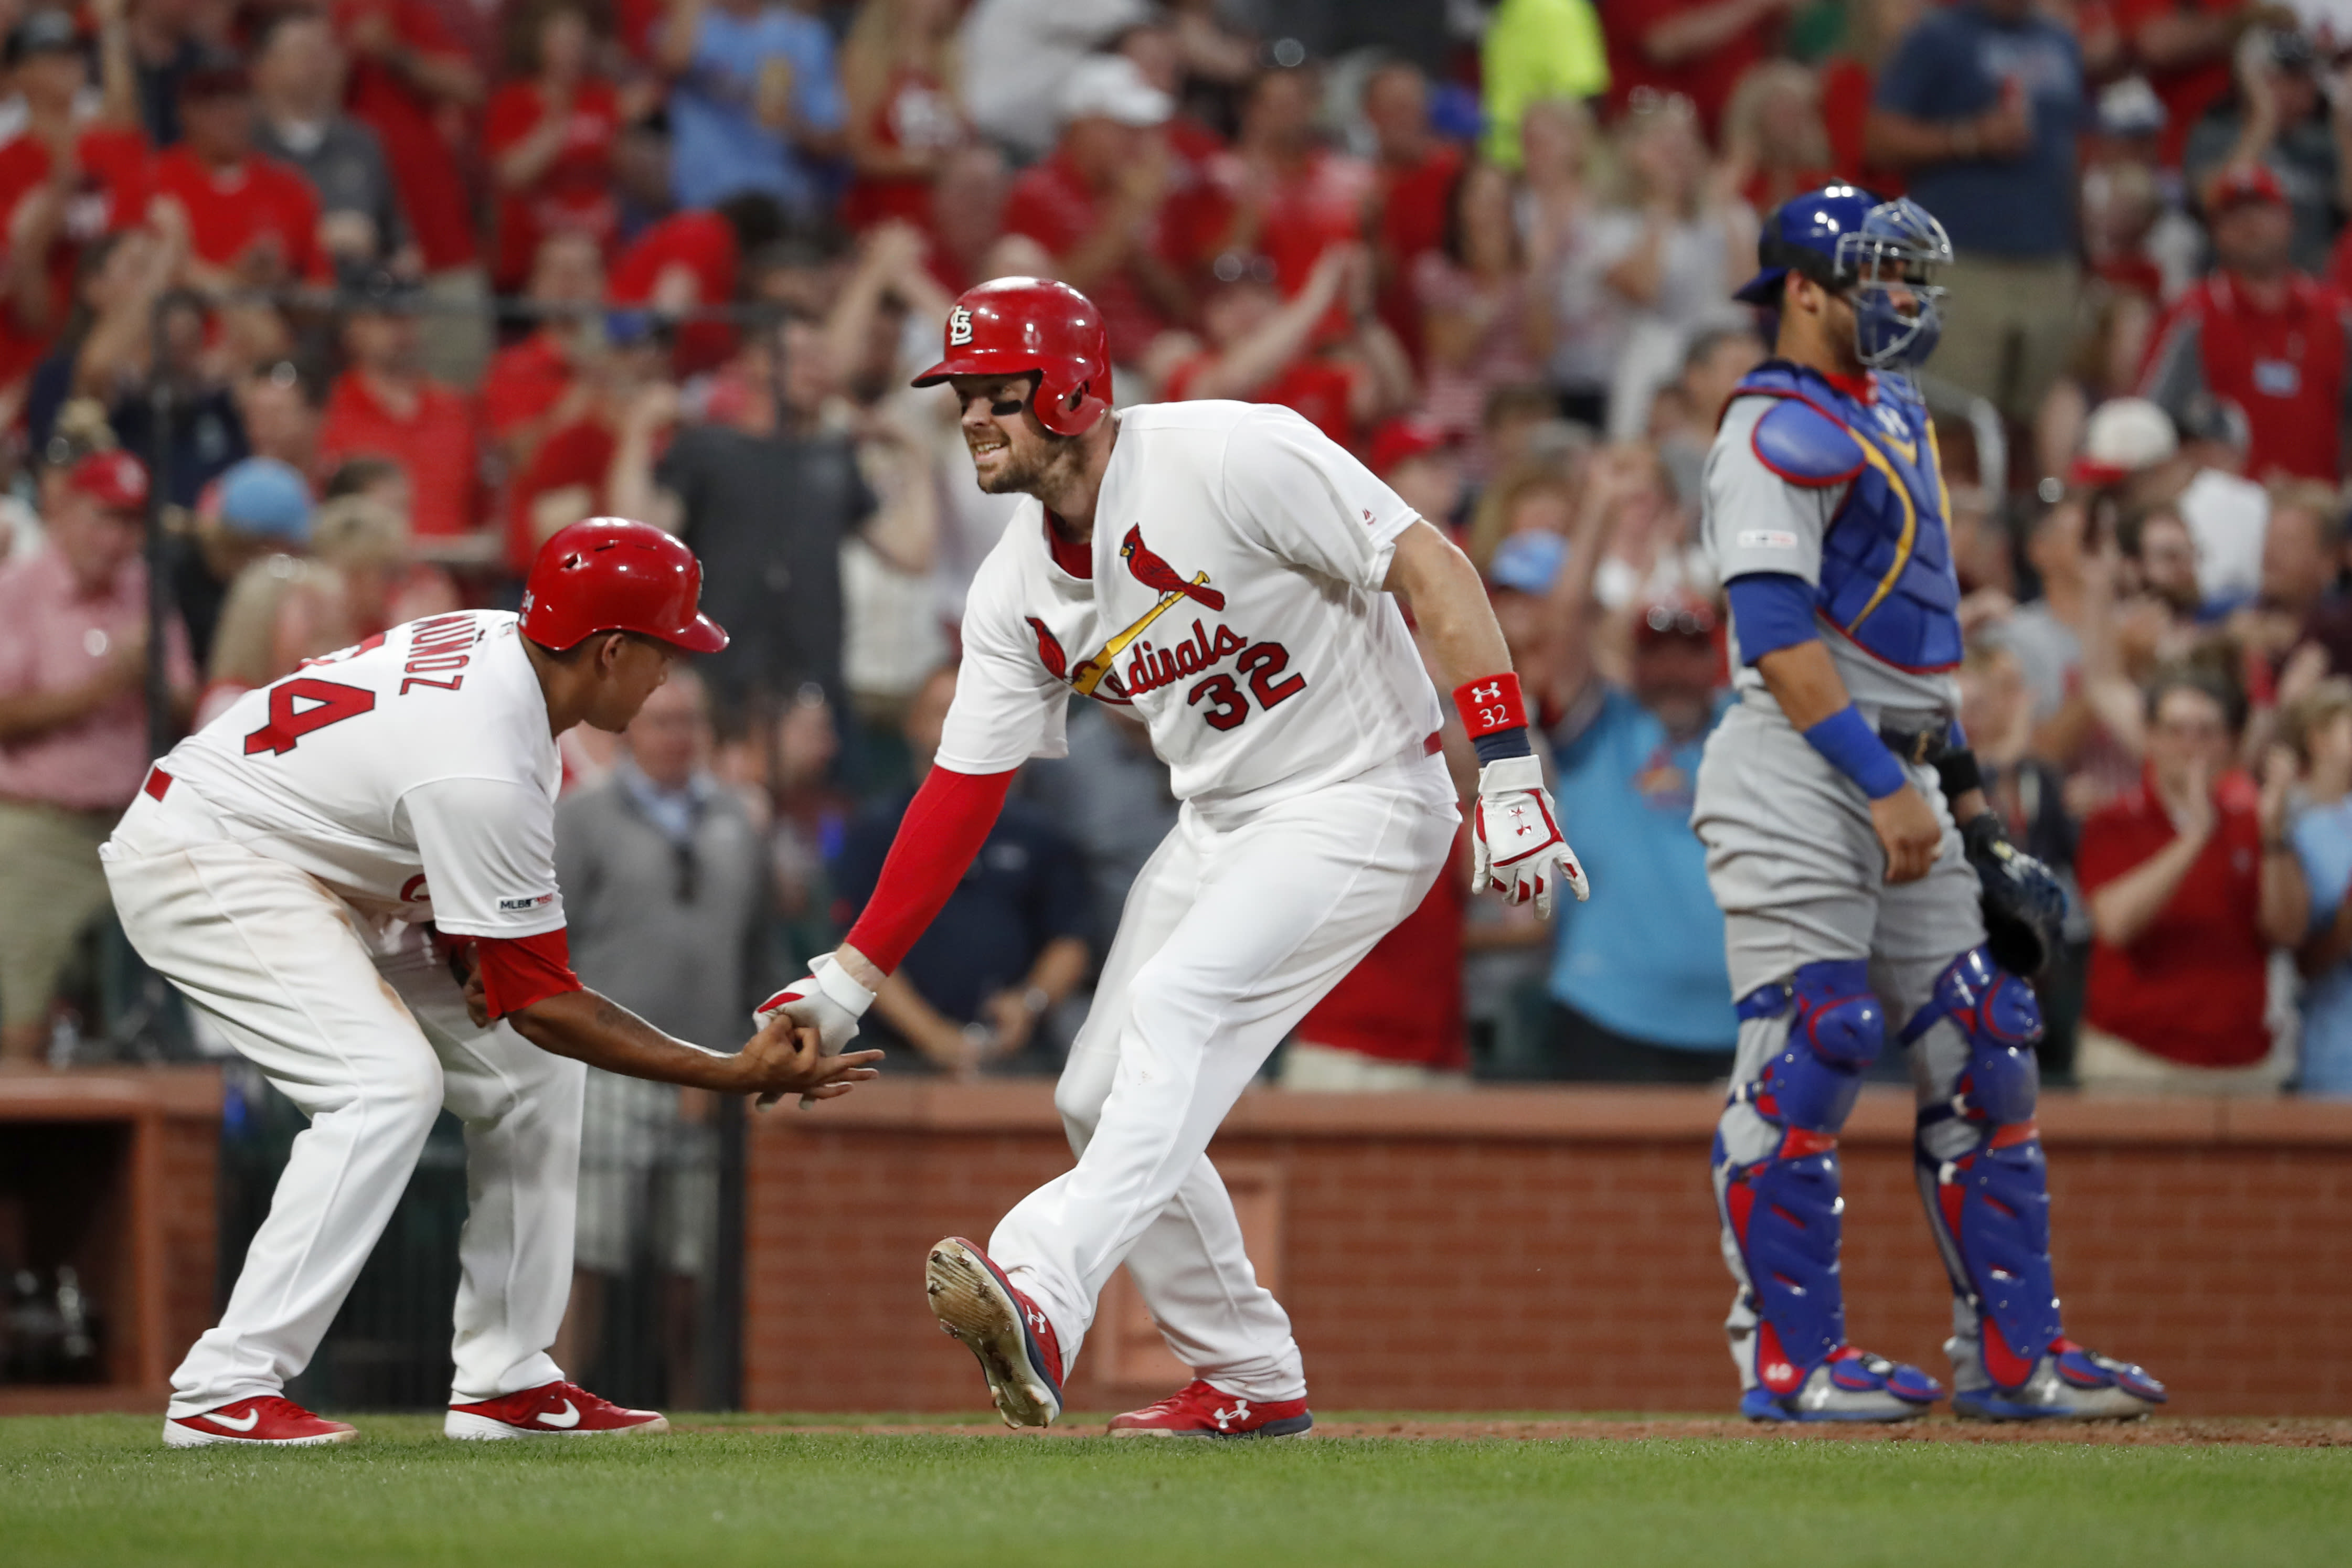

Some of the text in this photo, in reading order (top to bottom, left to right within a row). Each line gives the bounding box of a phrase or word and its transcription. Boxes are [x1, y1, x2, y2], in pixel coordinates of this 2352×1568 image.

[243, 632, 386, 756] 4
[1072, 619, 1248, 705] Cadinals
[1187, 642, 1307, 731] 32
[1479, 704, 1510, 728] 32
[500, 900, 526, 909] MLB
